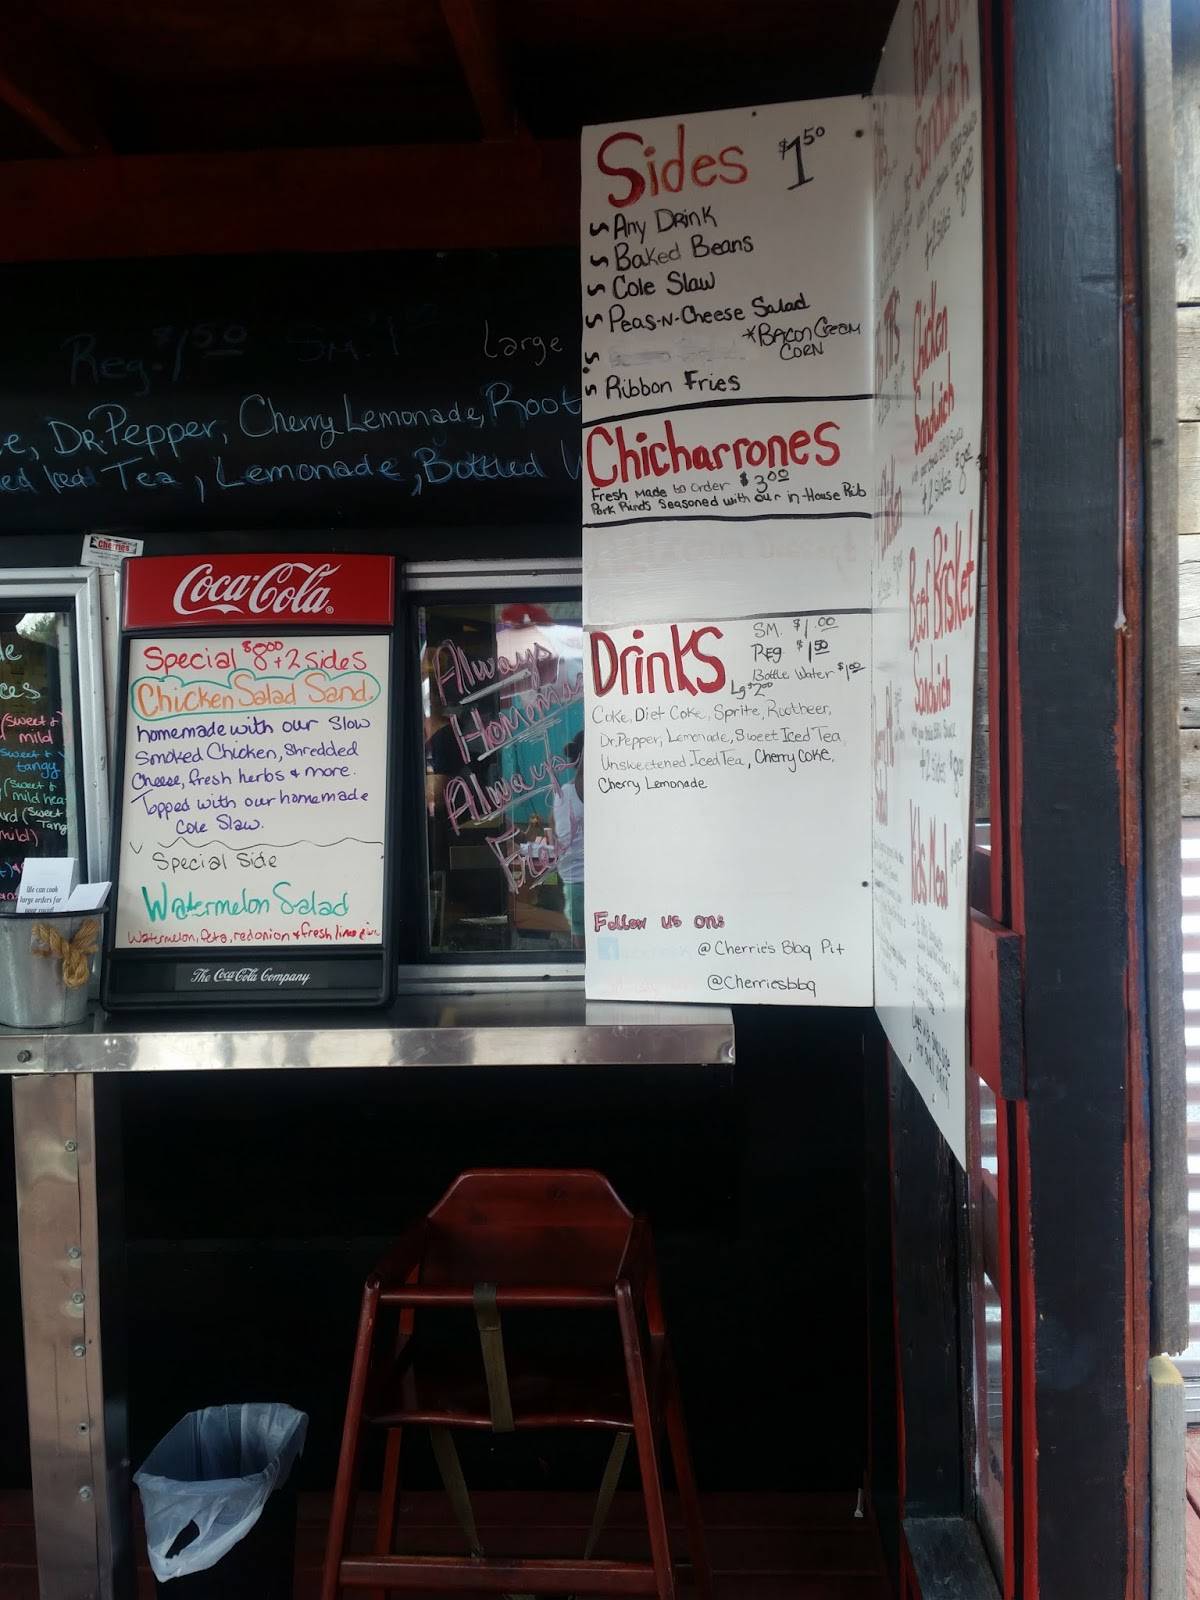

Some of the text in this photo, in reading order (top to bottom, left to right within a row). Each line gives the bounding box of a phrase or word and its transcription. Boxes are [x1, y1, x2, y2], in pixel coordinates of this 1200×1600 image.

[597, 123, 748, 208] Sides
[613, 213, 646, 244] Any
[614, 234, 754, 272] Baked Beans
[612, 271, 716, 300] Cole Slaw
[751, 293, 811, 318] Salad
[484, 318, 563, 367] Large
[605, 371, 741, 400] Ribbon Fries
[485, 382, 582, 421] Root
[586, 419, 841, 488] Chicharrones
[591, 487, 628, 502] Fresh
[672, 483, 686, 495] to
[591, 502, 616, 516] Pork
[658, 496, 720, 510] Seasoned
[723, 492, 751, 507] with
[754, 492, 782, 503] our
[144, 646, 236, 675] Special
[590, 624, 726, 698] Drinks
[752, 668, 790, 682] Bottle
[795, 665, 835, 680] Water
[138, 681, 233, 718] Chicken
[232, 673, 297, 708] Salad
[731, 680, 746, 700] Lg
[635, 706, 665, 722] Diet
[137, 715, 371, 743] homemade with our Slow
[781, 727, 811, 743] Iced
[135, 746, 204, 766] Smoked
[755, 748, 797, 773] Cherry
[188, 768, 232, 787] fresh
[239, 767, 285, 784] herbs
[598, 776, 708, 795] Cherry Lemonade
[131, 788, 369, 820] Topped with our homemade
[176, 819, 208, 835] Cole
[152, 851, 278, 874] Special Side
[141, 881, 349, 922] Watermelon Salad
[300, 921, 332, 941] fresh
[594, 911, 648, 932] Follow
[661, 915, 682, 930] us
[821, 938, 846, 956] Pit
[190, 967, 211, 983] The
[261, 967, 310, 986] Company
